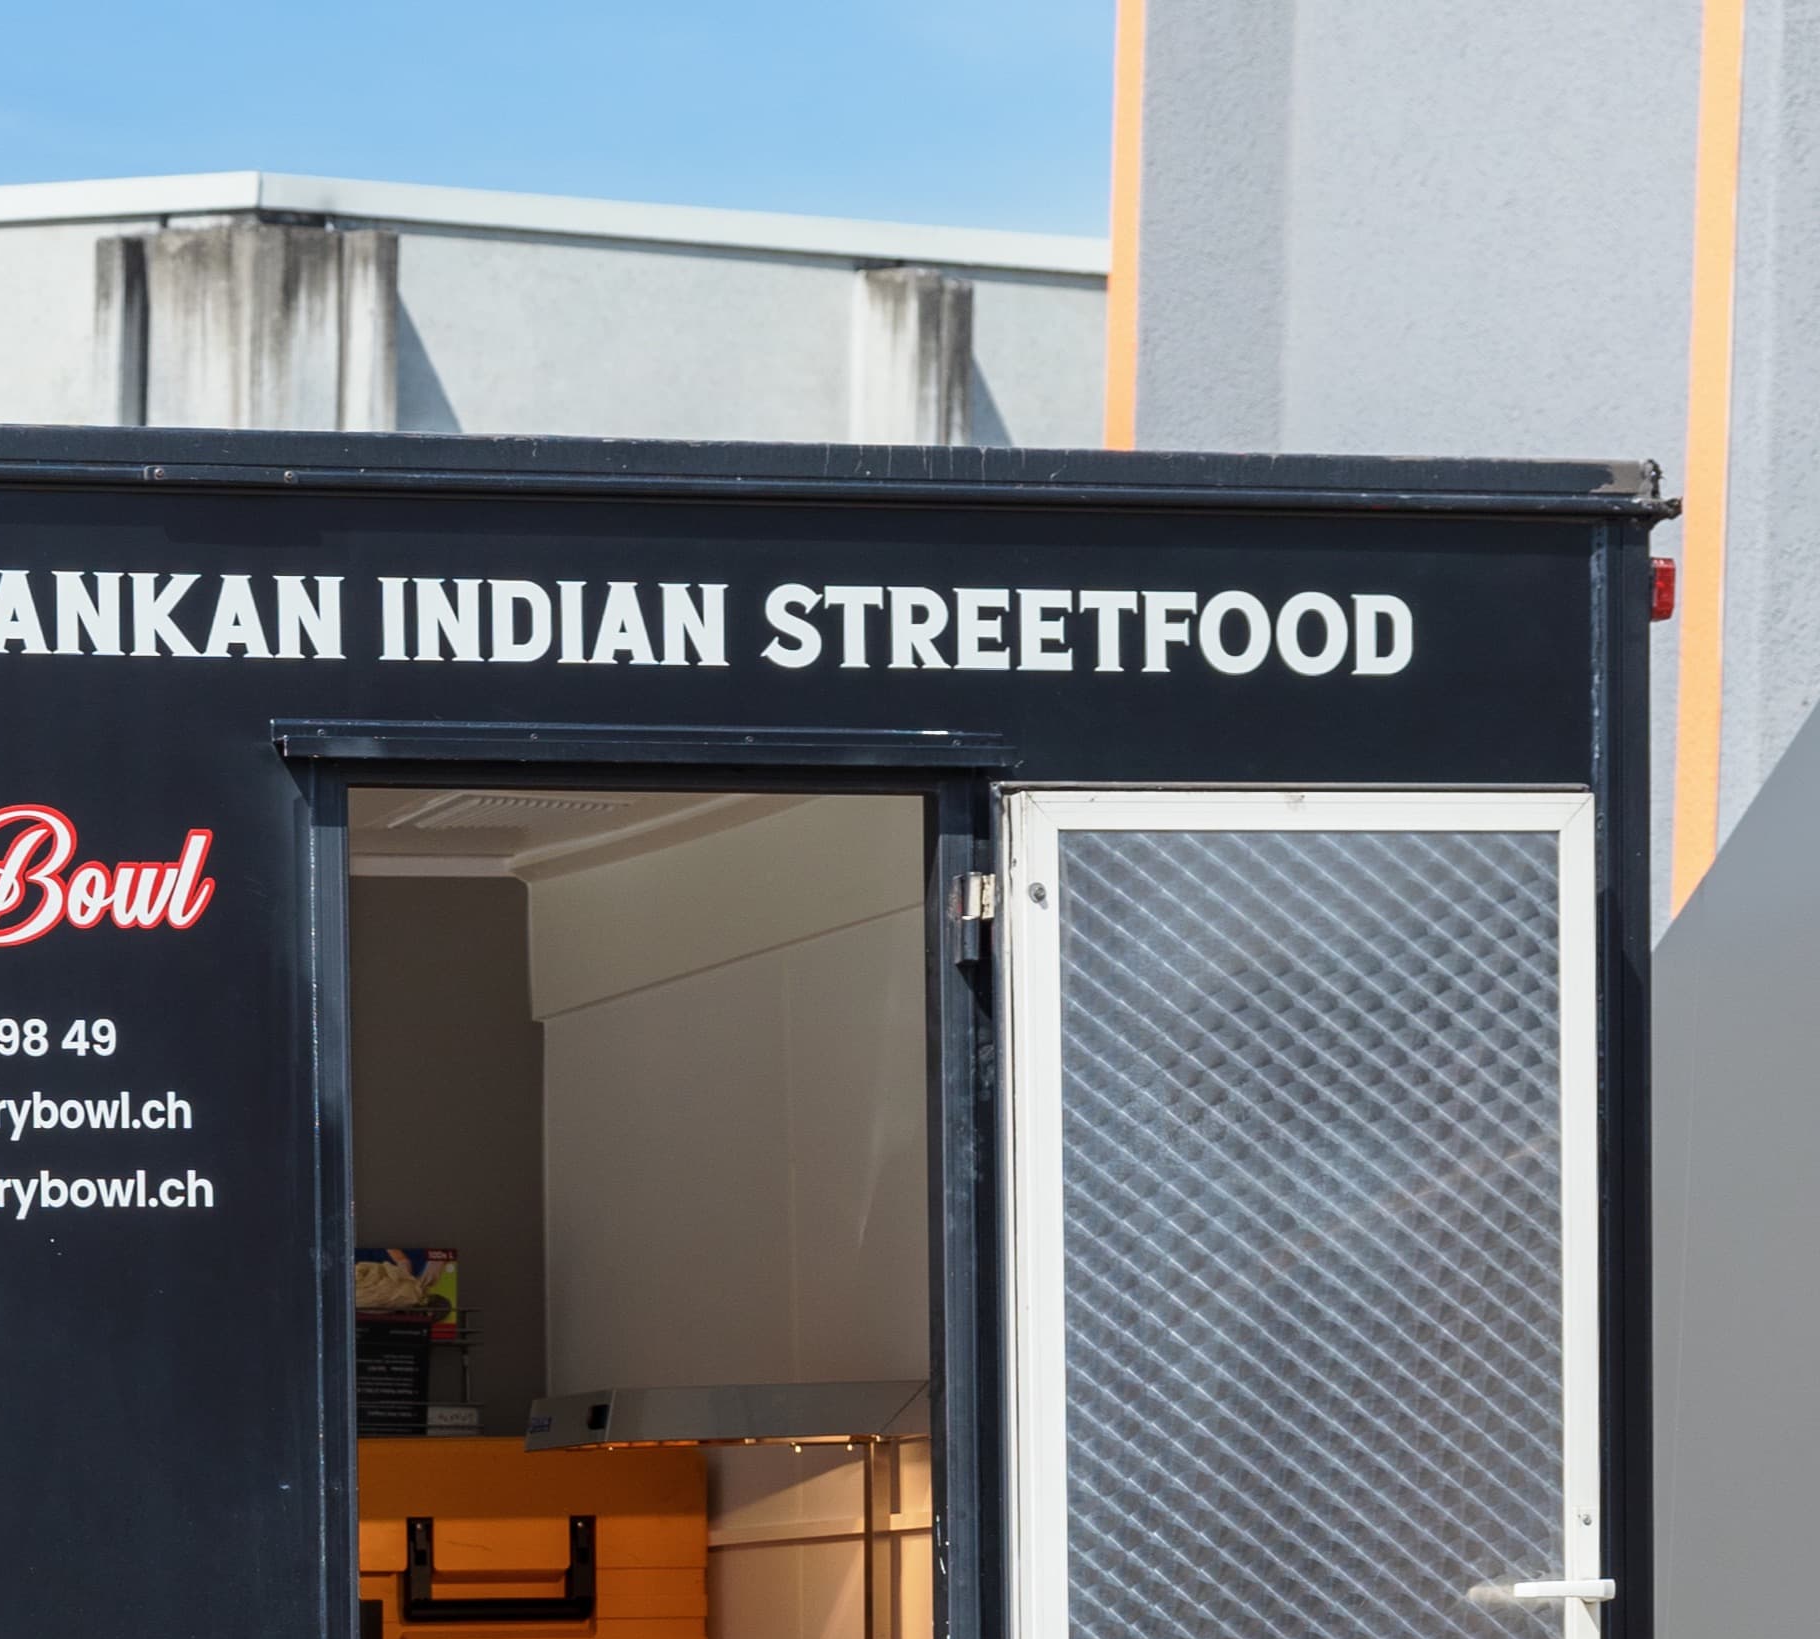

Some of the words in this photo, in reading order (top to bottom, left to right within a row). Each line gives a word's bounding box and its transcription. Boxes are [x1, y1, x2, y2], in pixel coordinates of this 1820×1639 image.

[378, 576, 729, 667] INDIAN
[761, 584, 1415, 677] STREETFOOD
[61, 1018, 118, 1057] 49
